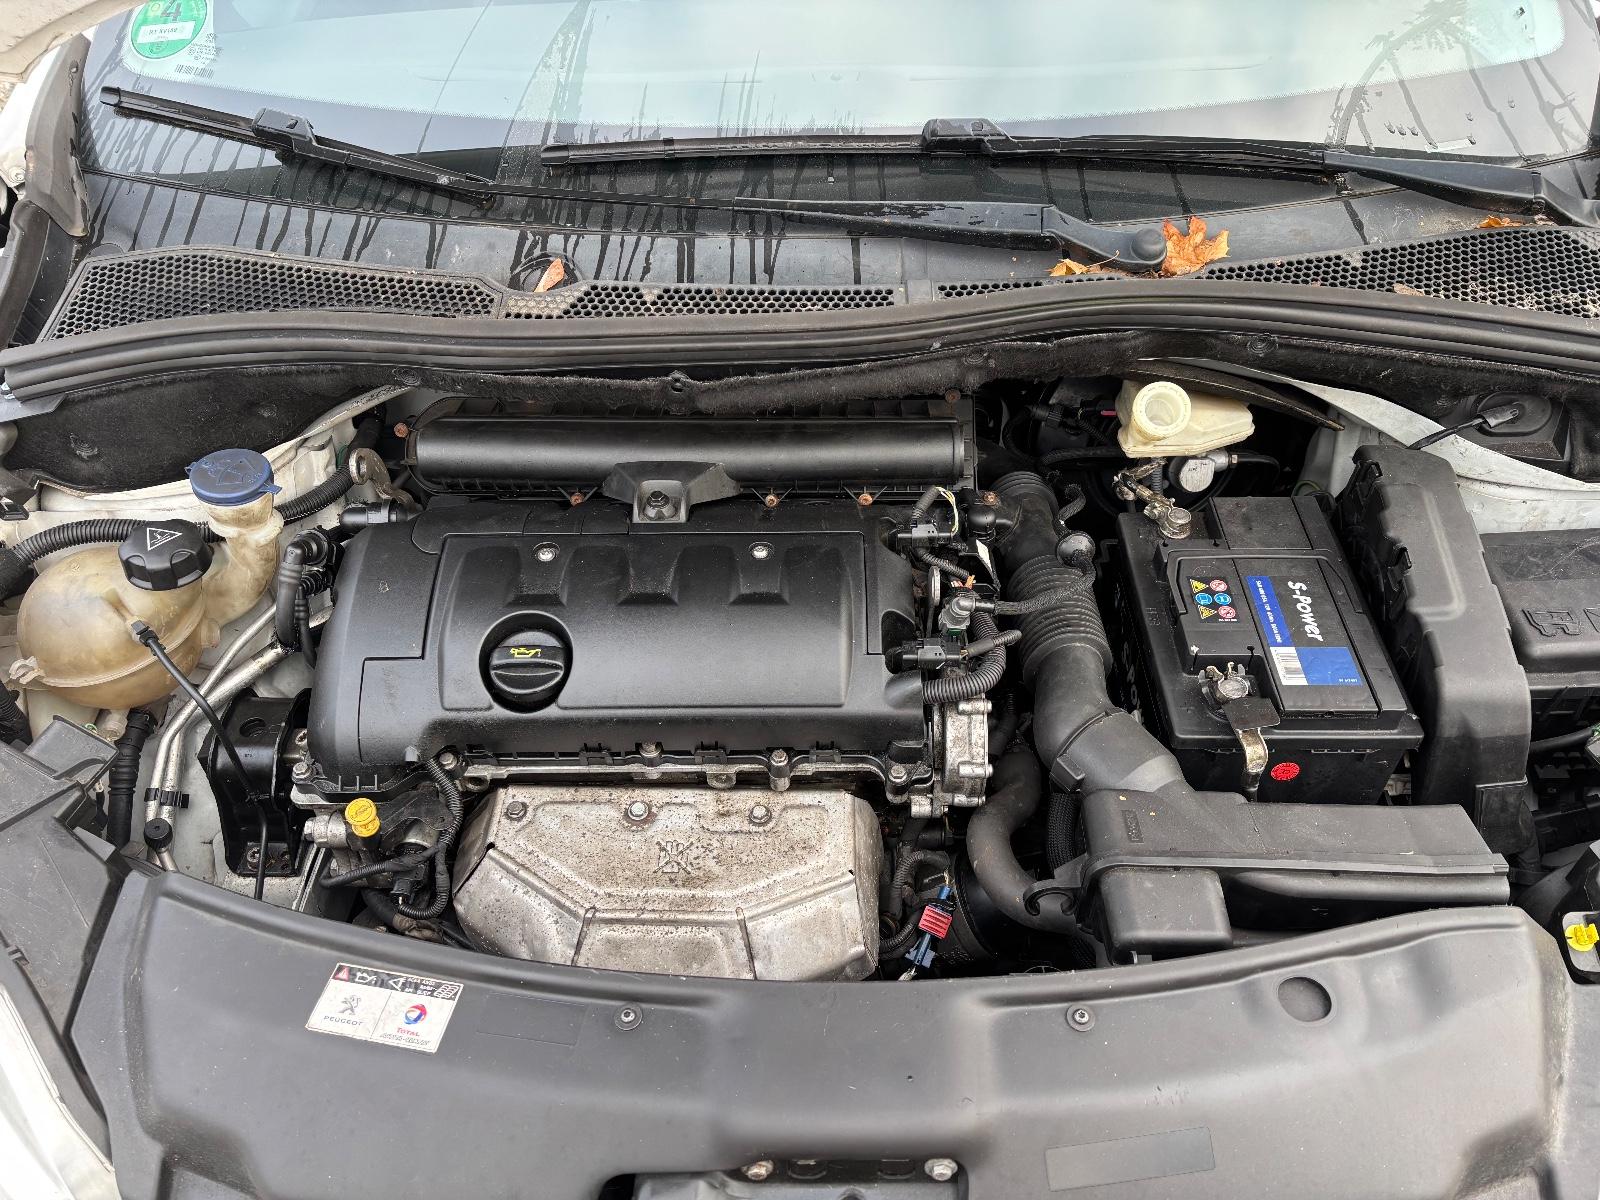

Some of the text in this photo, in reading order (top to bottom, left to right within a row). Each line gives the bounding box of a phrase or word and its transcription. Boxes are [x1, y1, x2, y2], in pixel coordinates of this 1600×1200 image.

[160, 0, 182, 21] 4
[323, 1015, 365, 1026] PEUGEOT
[396, 1027, 421, 1037] TOTAL
